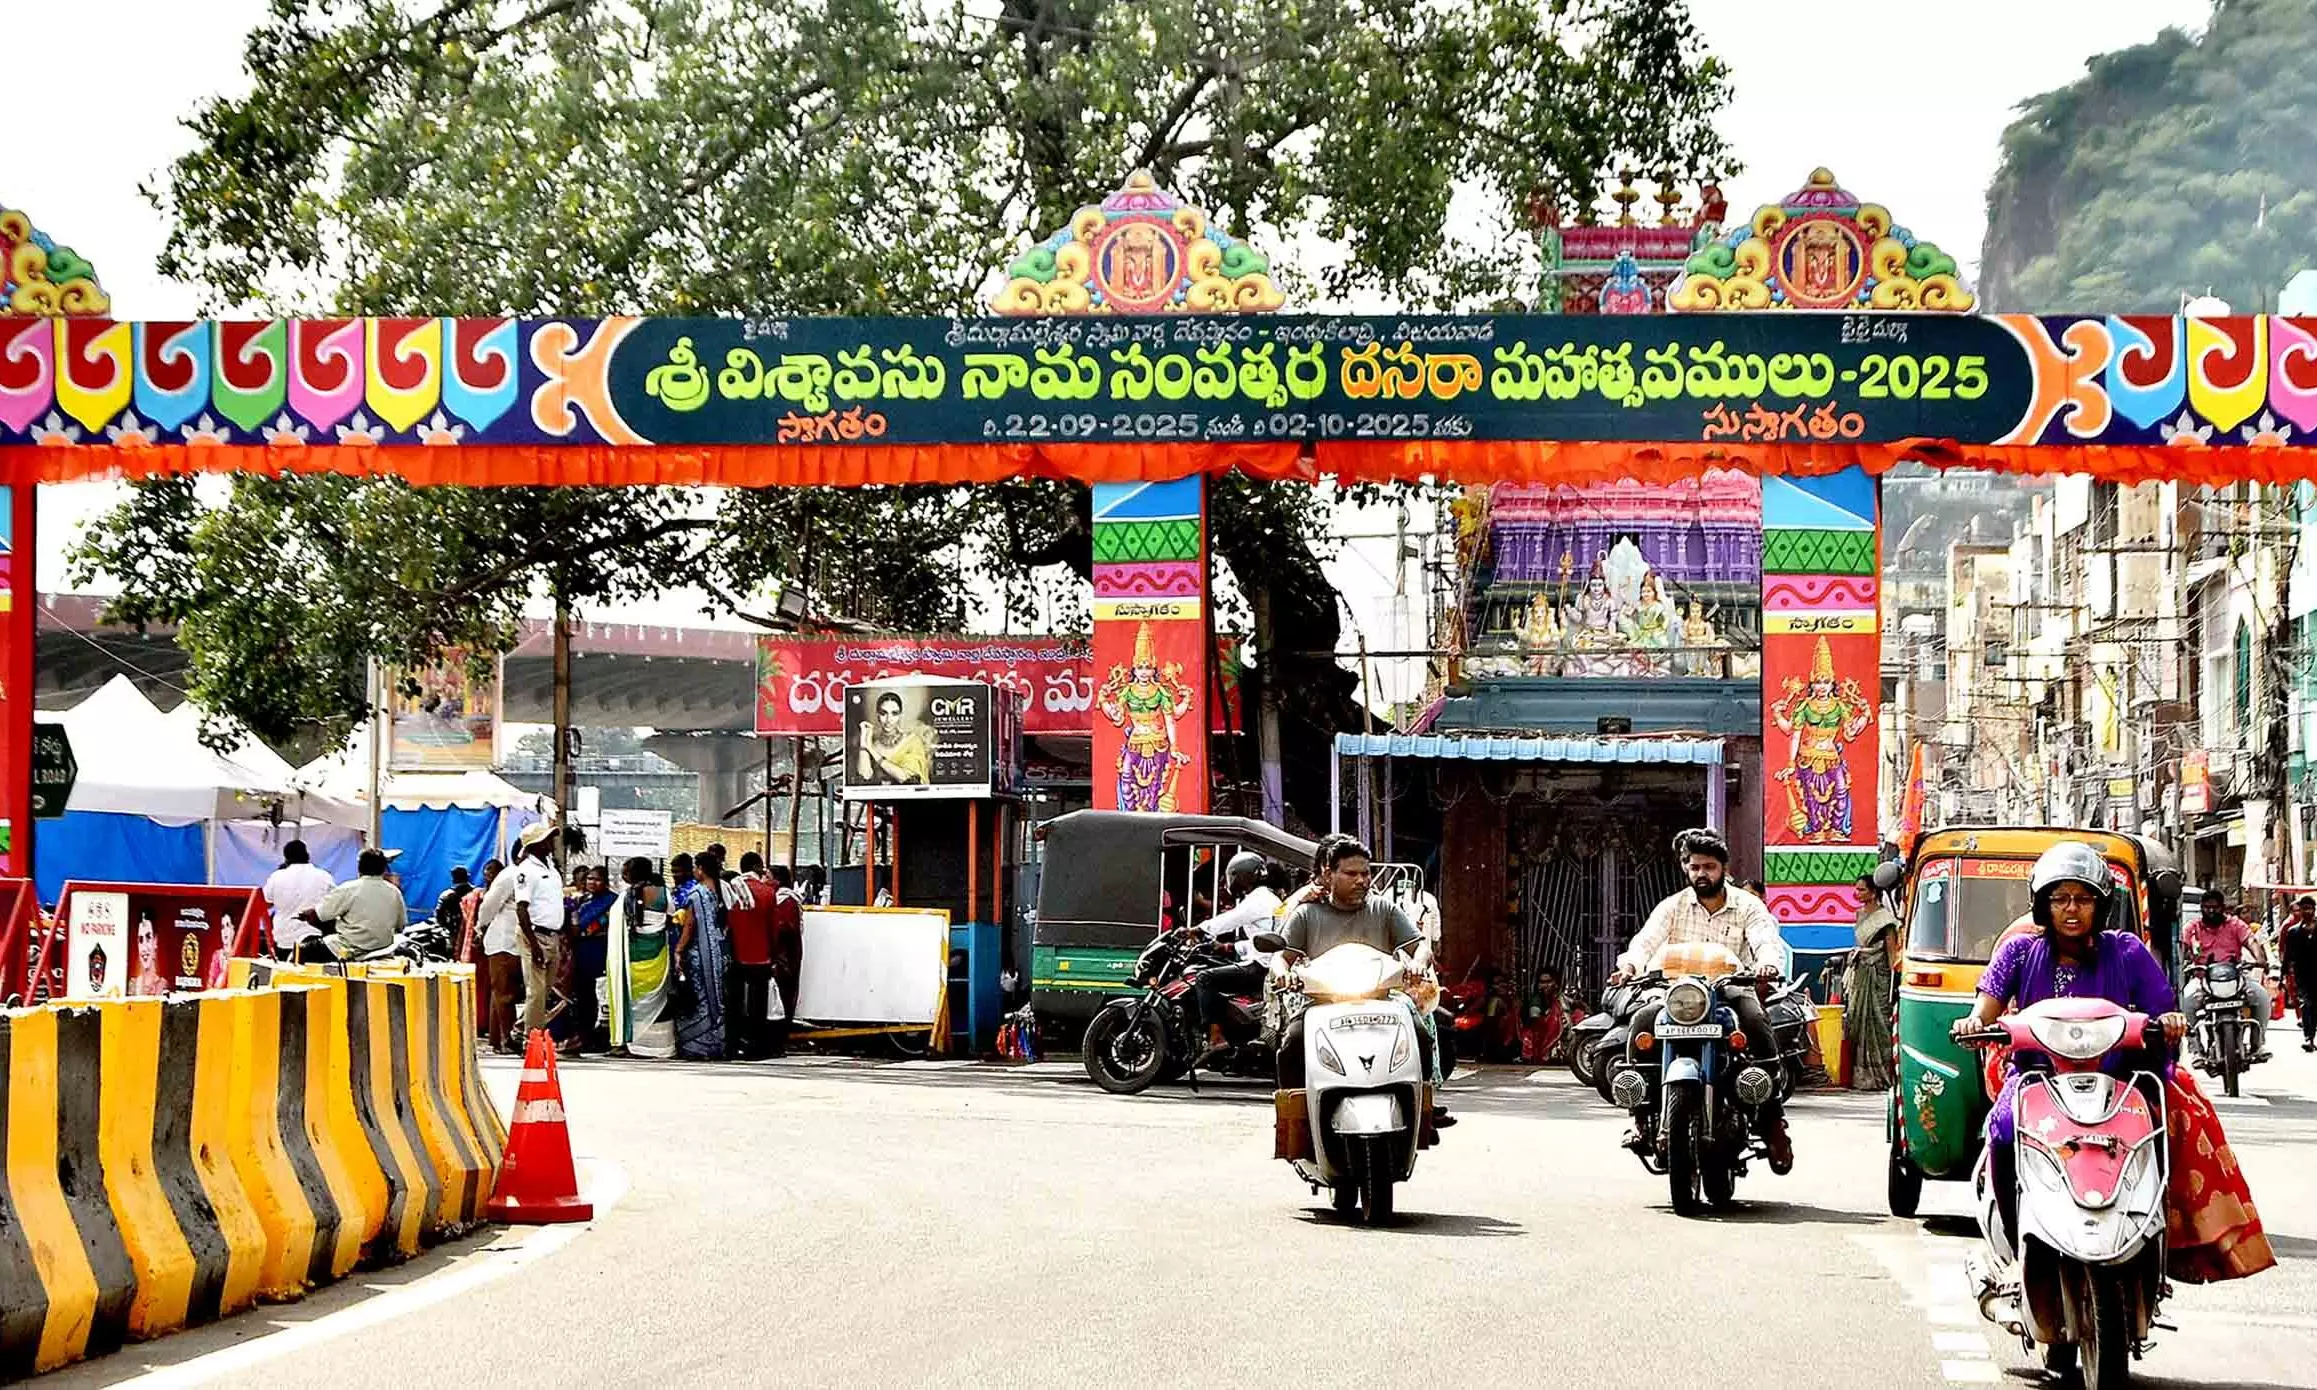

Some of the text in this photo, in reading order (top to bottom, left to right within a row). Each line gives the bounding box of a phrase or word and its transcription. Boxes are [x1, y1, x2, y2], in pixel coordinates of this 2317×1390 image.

[645, 336, 710, 412] శ్రీ
[961, 343, 1102, 400] నామ
[1110, 341, 1328, 408] సంవత్సర
[1341, 341, 1484, 400] దసరా
[776, 405, 888, 443] స్వాగతం
[1702, 400, 1867, 442] సుస్వాగతం
[931, 696, 975, 716] CMR
